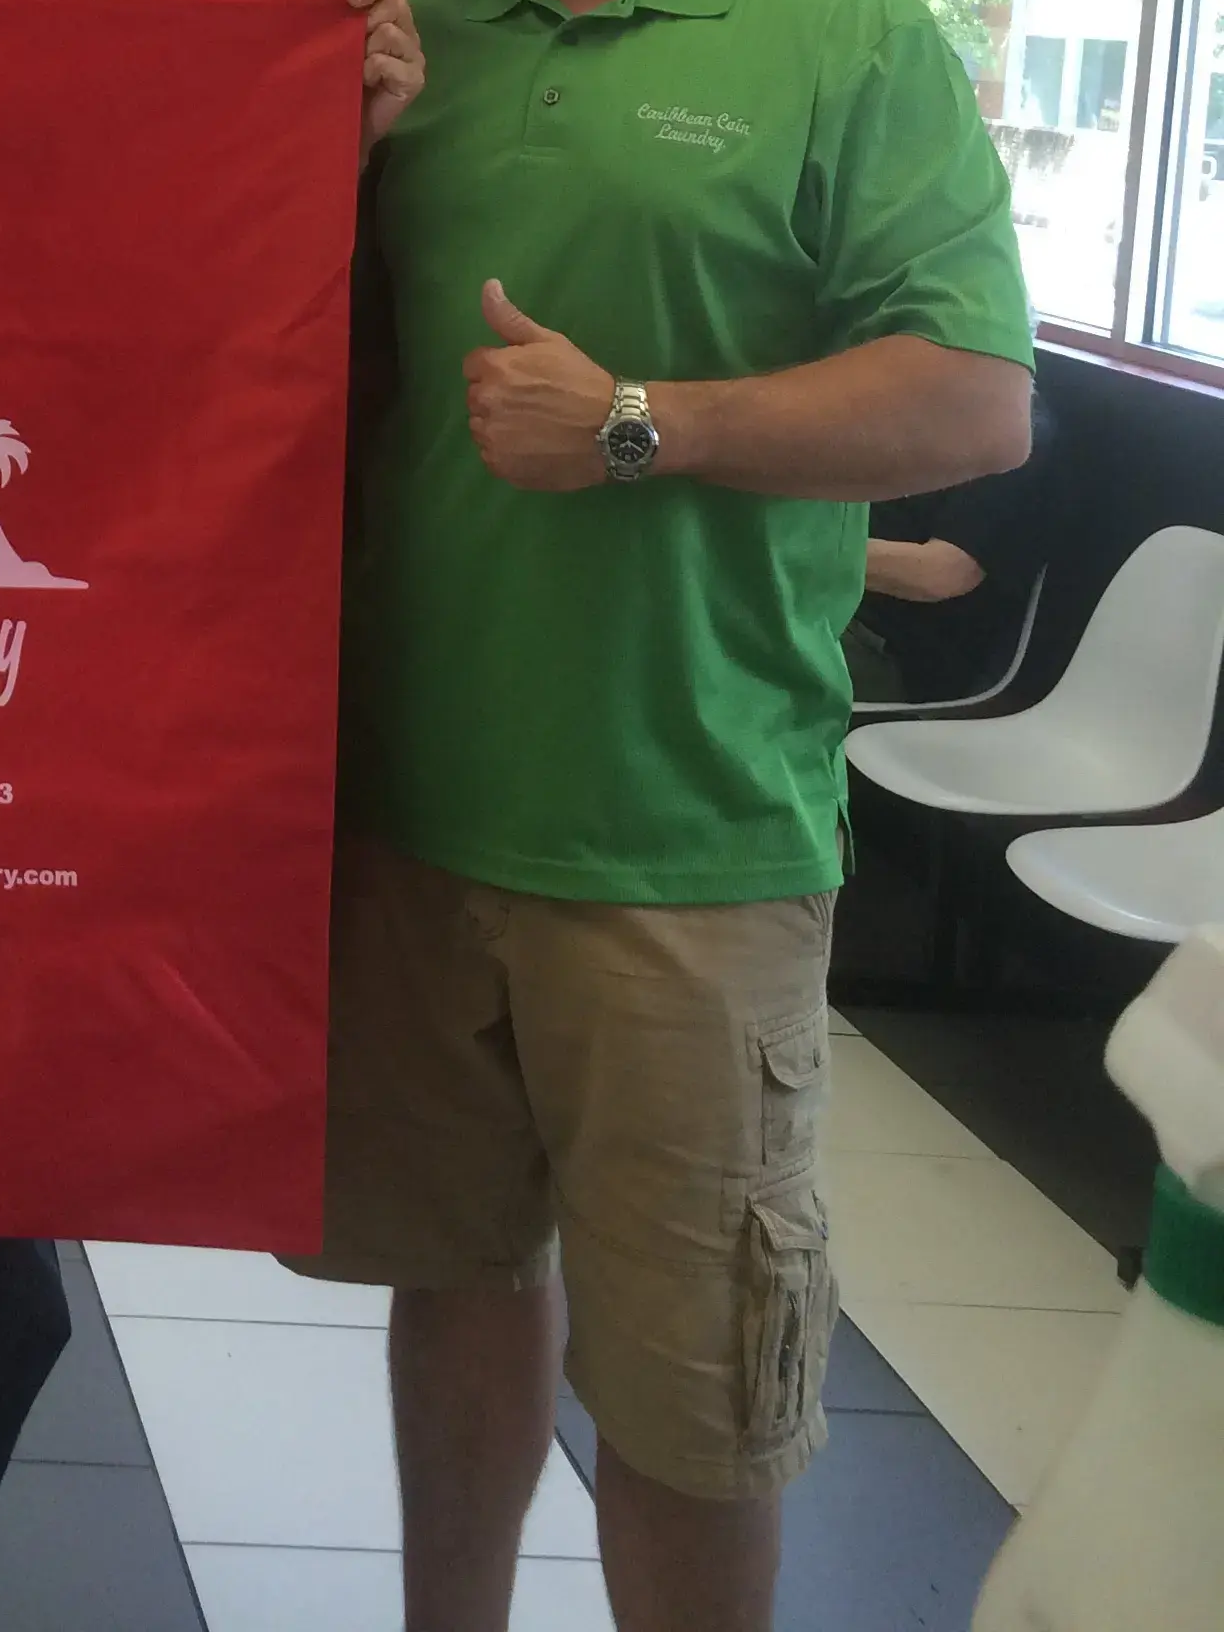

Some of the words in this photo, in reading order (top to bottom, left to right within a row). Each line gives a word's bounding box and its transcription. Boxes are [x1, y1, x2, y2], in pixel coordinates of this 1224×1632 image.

[637, 103, 713, 127] Caribbean
[716, 112, 751, 136] Coin
[654, 123, 726, 154] Laundry
